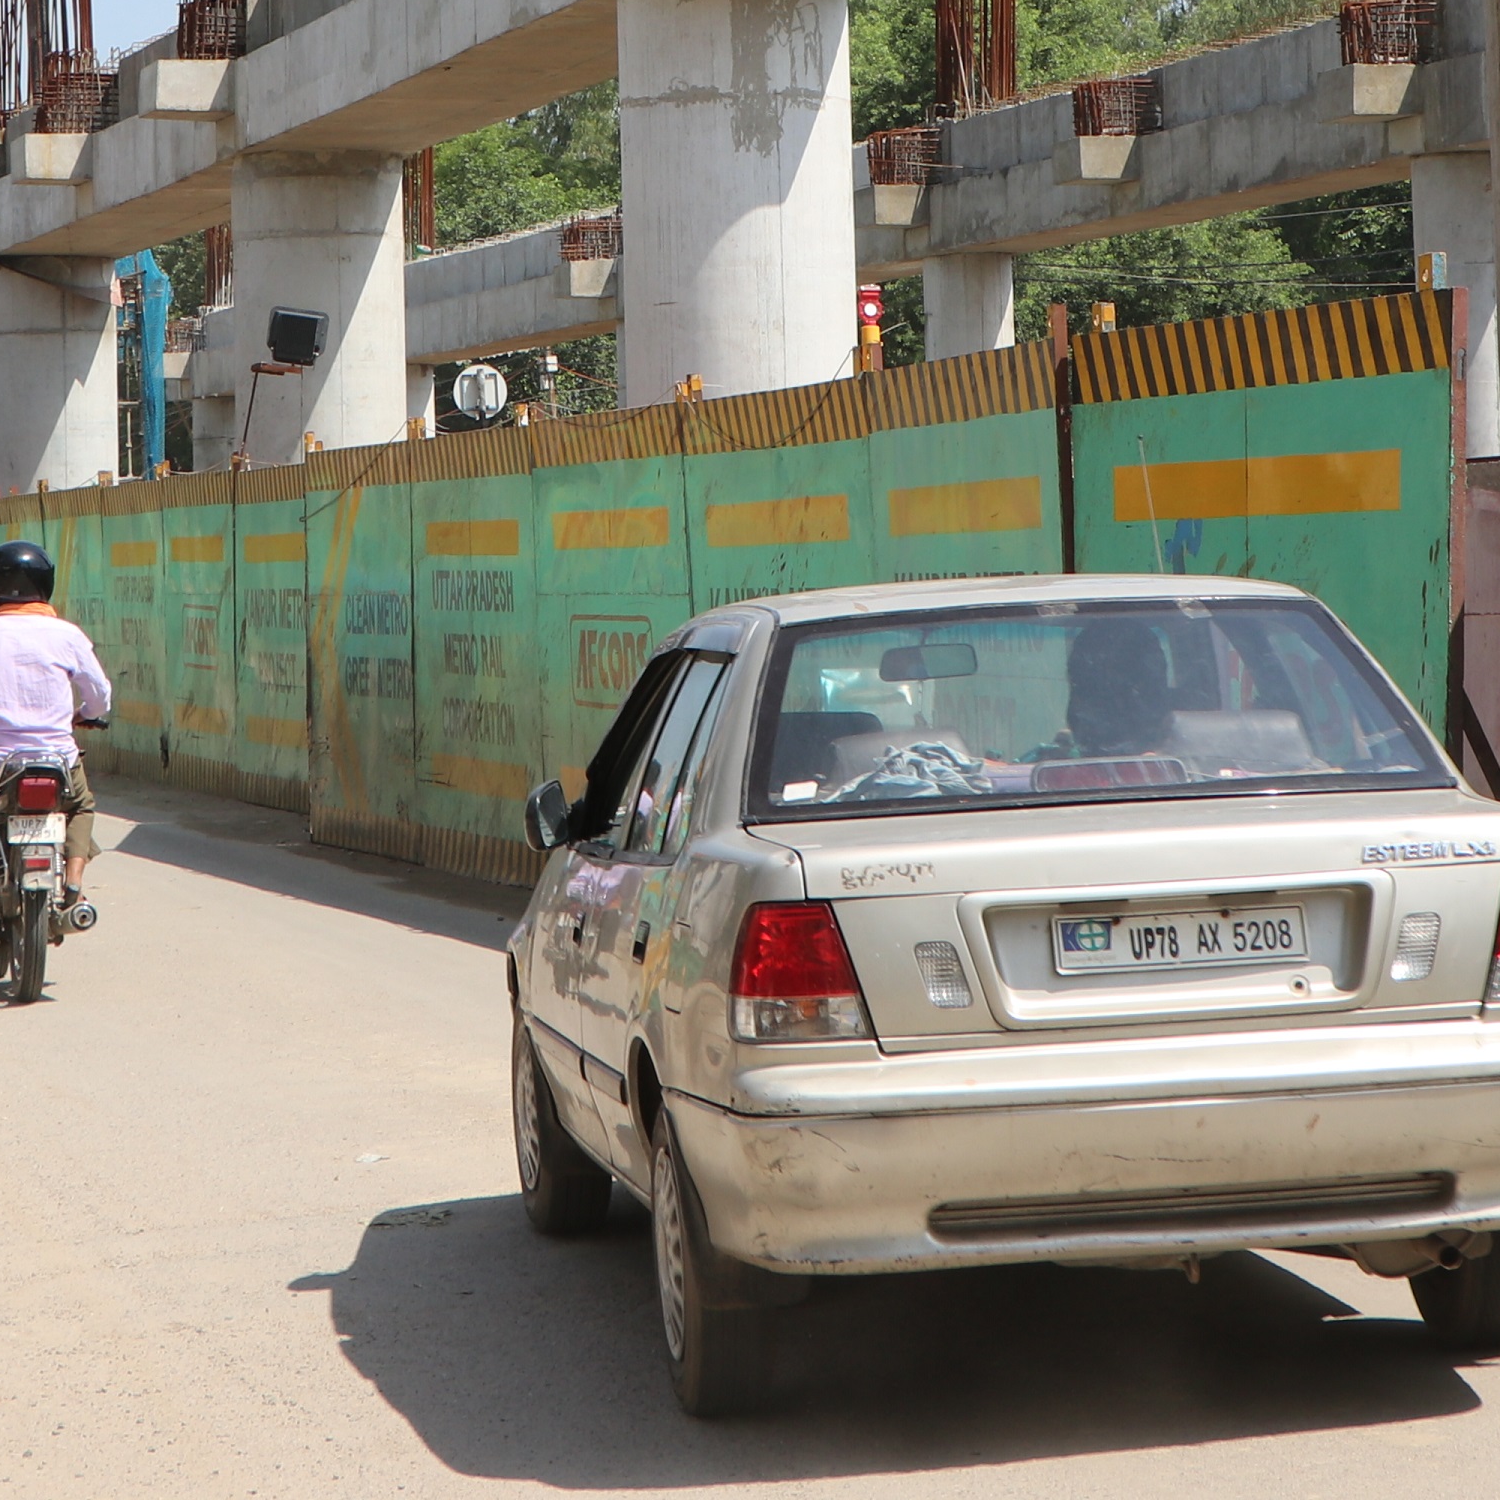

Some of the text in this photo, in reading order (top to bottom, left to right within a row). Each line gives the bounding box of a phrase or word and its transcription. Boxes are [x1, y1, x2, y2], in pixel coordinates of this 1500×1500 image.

[431, 570, 514, 613] UTTAR PRADESH
[345, 594, 409, 636] CLEAN METRO
[443, 633, 506, 679] METRO RAIL
[345, 656, 412, 700] GREE METRO
[1362, 842, 1450, 863] ESTEEM
[1129, 919, 1294, 961] UP78 AX 5208
